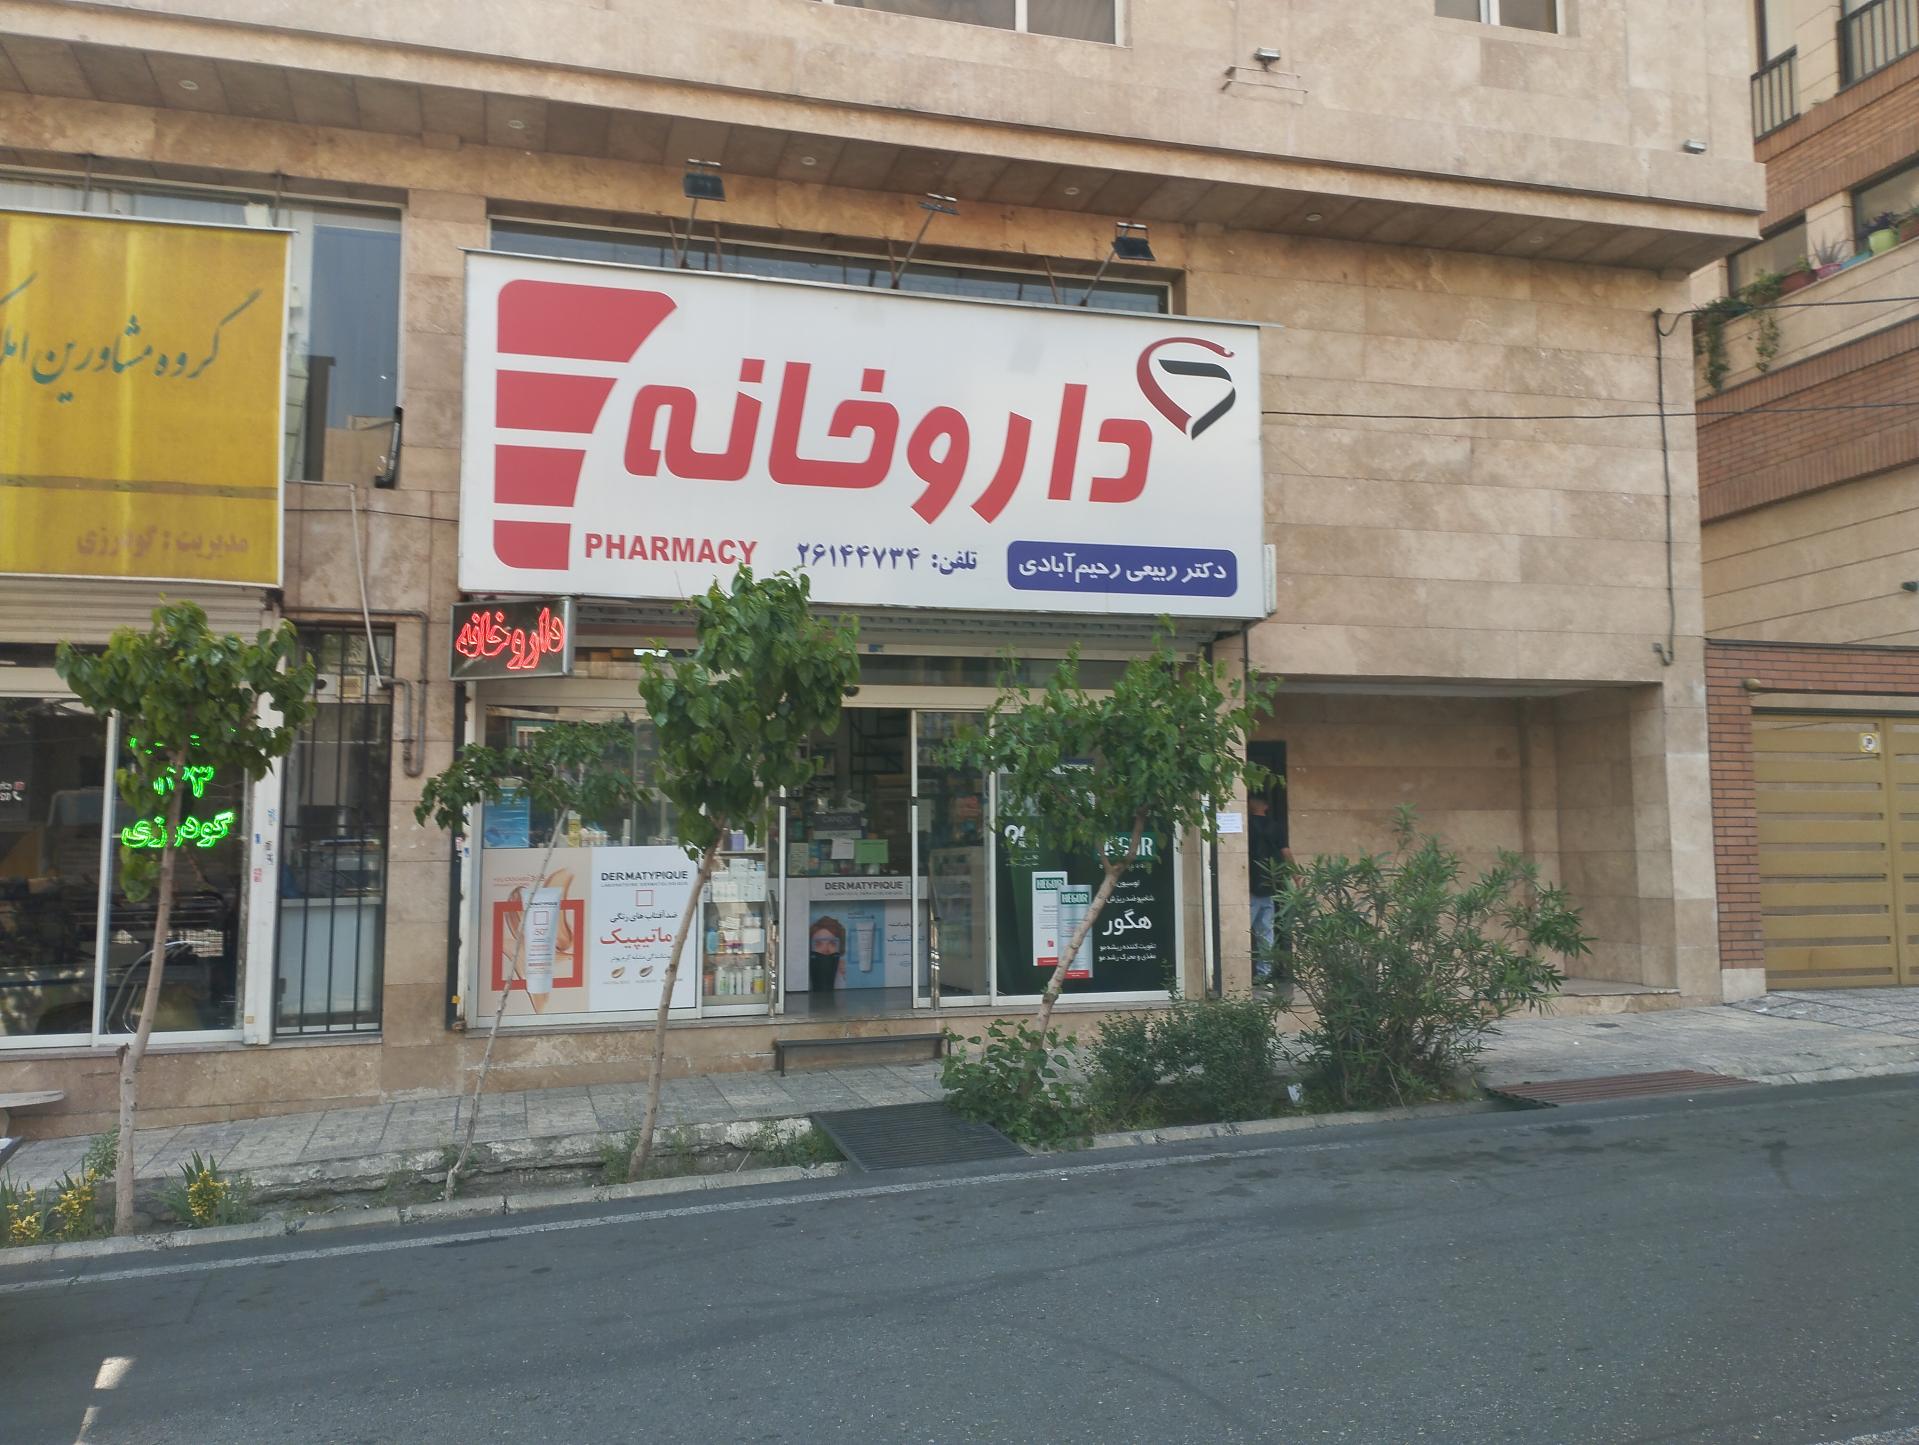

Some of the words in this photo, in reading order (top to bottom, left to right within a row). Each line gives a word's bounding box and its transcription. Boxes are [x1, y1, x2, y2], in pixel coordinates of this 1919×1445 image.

[31, 313, 154, 404] مشاورین
[624, 357, 1153, 525] داروخانه
[585, 532, 758, 566] PHARMACY
[797, 542, 920, 571] ۲۶۱۴۴۷۳۴
[1126, 563, 1177, 583] ربیعی
[1181, 561, 1227, 584] دکتر
[456, 607, 566, 669] داروخانه
[601, 870, 688, 881] DERMATYPIQUE
[825, 881, 904, 890] DERMATYPIQUE
[1102, 909, 1153, 936] هگور
